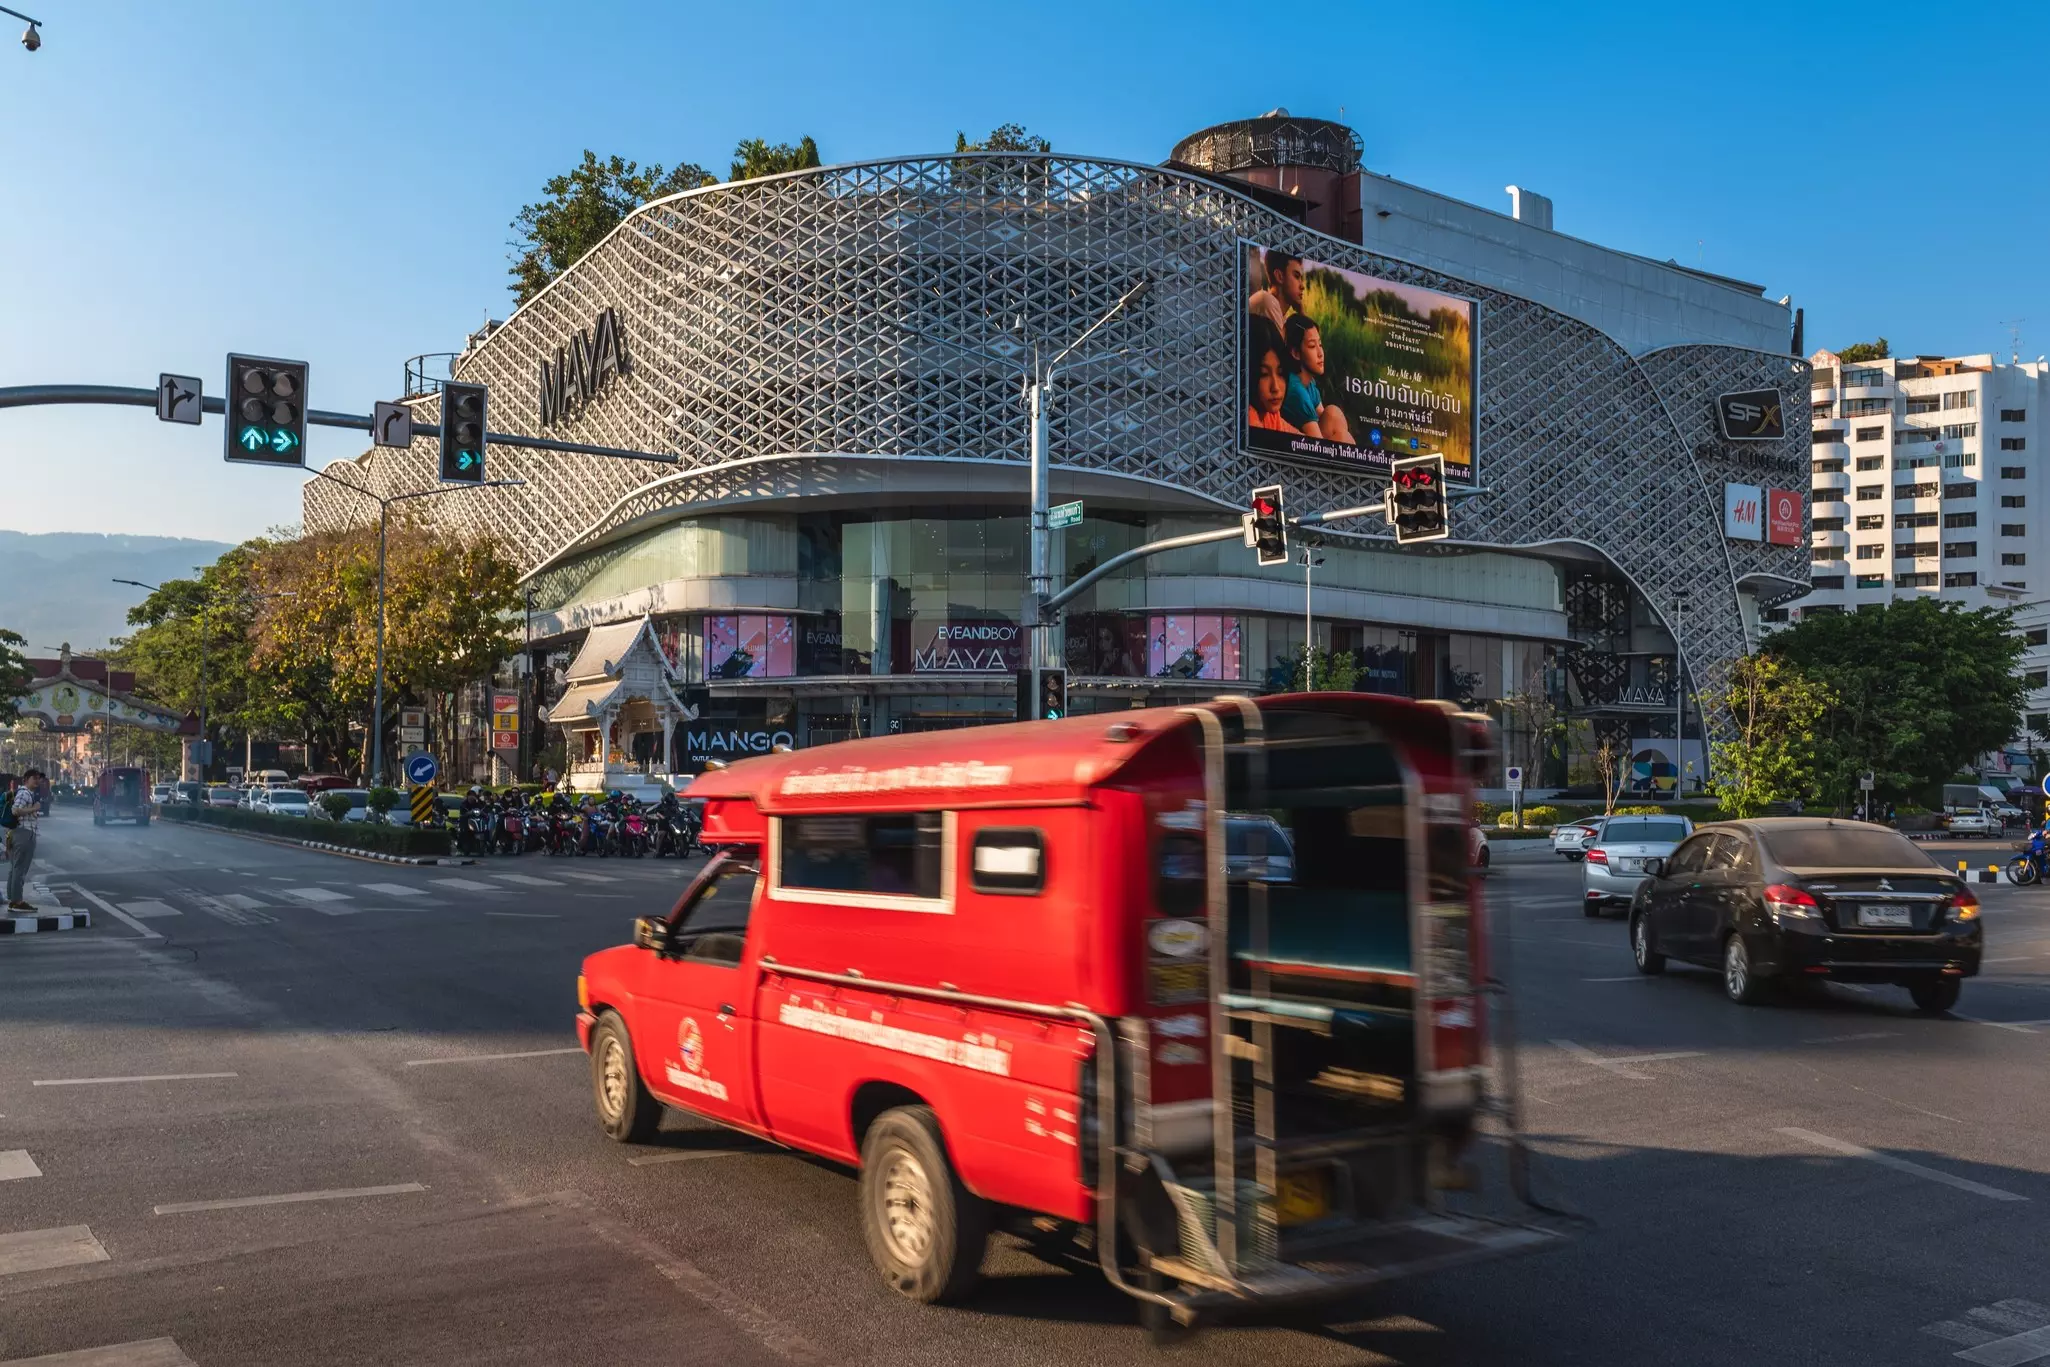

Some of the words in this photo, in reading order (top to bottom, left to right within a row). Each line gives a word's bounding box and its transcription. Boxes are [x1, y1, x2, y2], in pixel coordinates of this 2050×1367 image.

[541, 306, 622, 426] MAYA
[1345, 376, 1461, 414] เธอกับฉันกับฉัน
[1728, 402, 1781, 434] SFX
[1733, 500, 1757, 525] H&M
[938, 625, 1019, 641] EVEANDBOY
[915, 649, 1007, 669] MAYA
[1619, 686, 1666, 704] MAYA
[687, 730, 794, 751] MANGO
